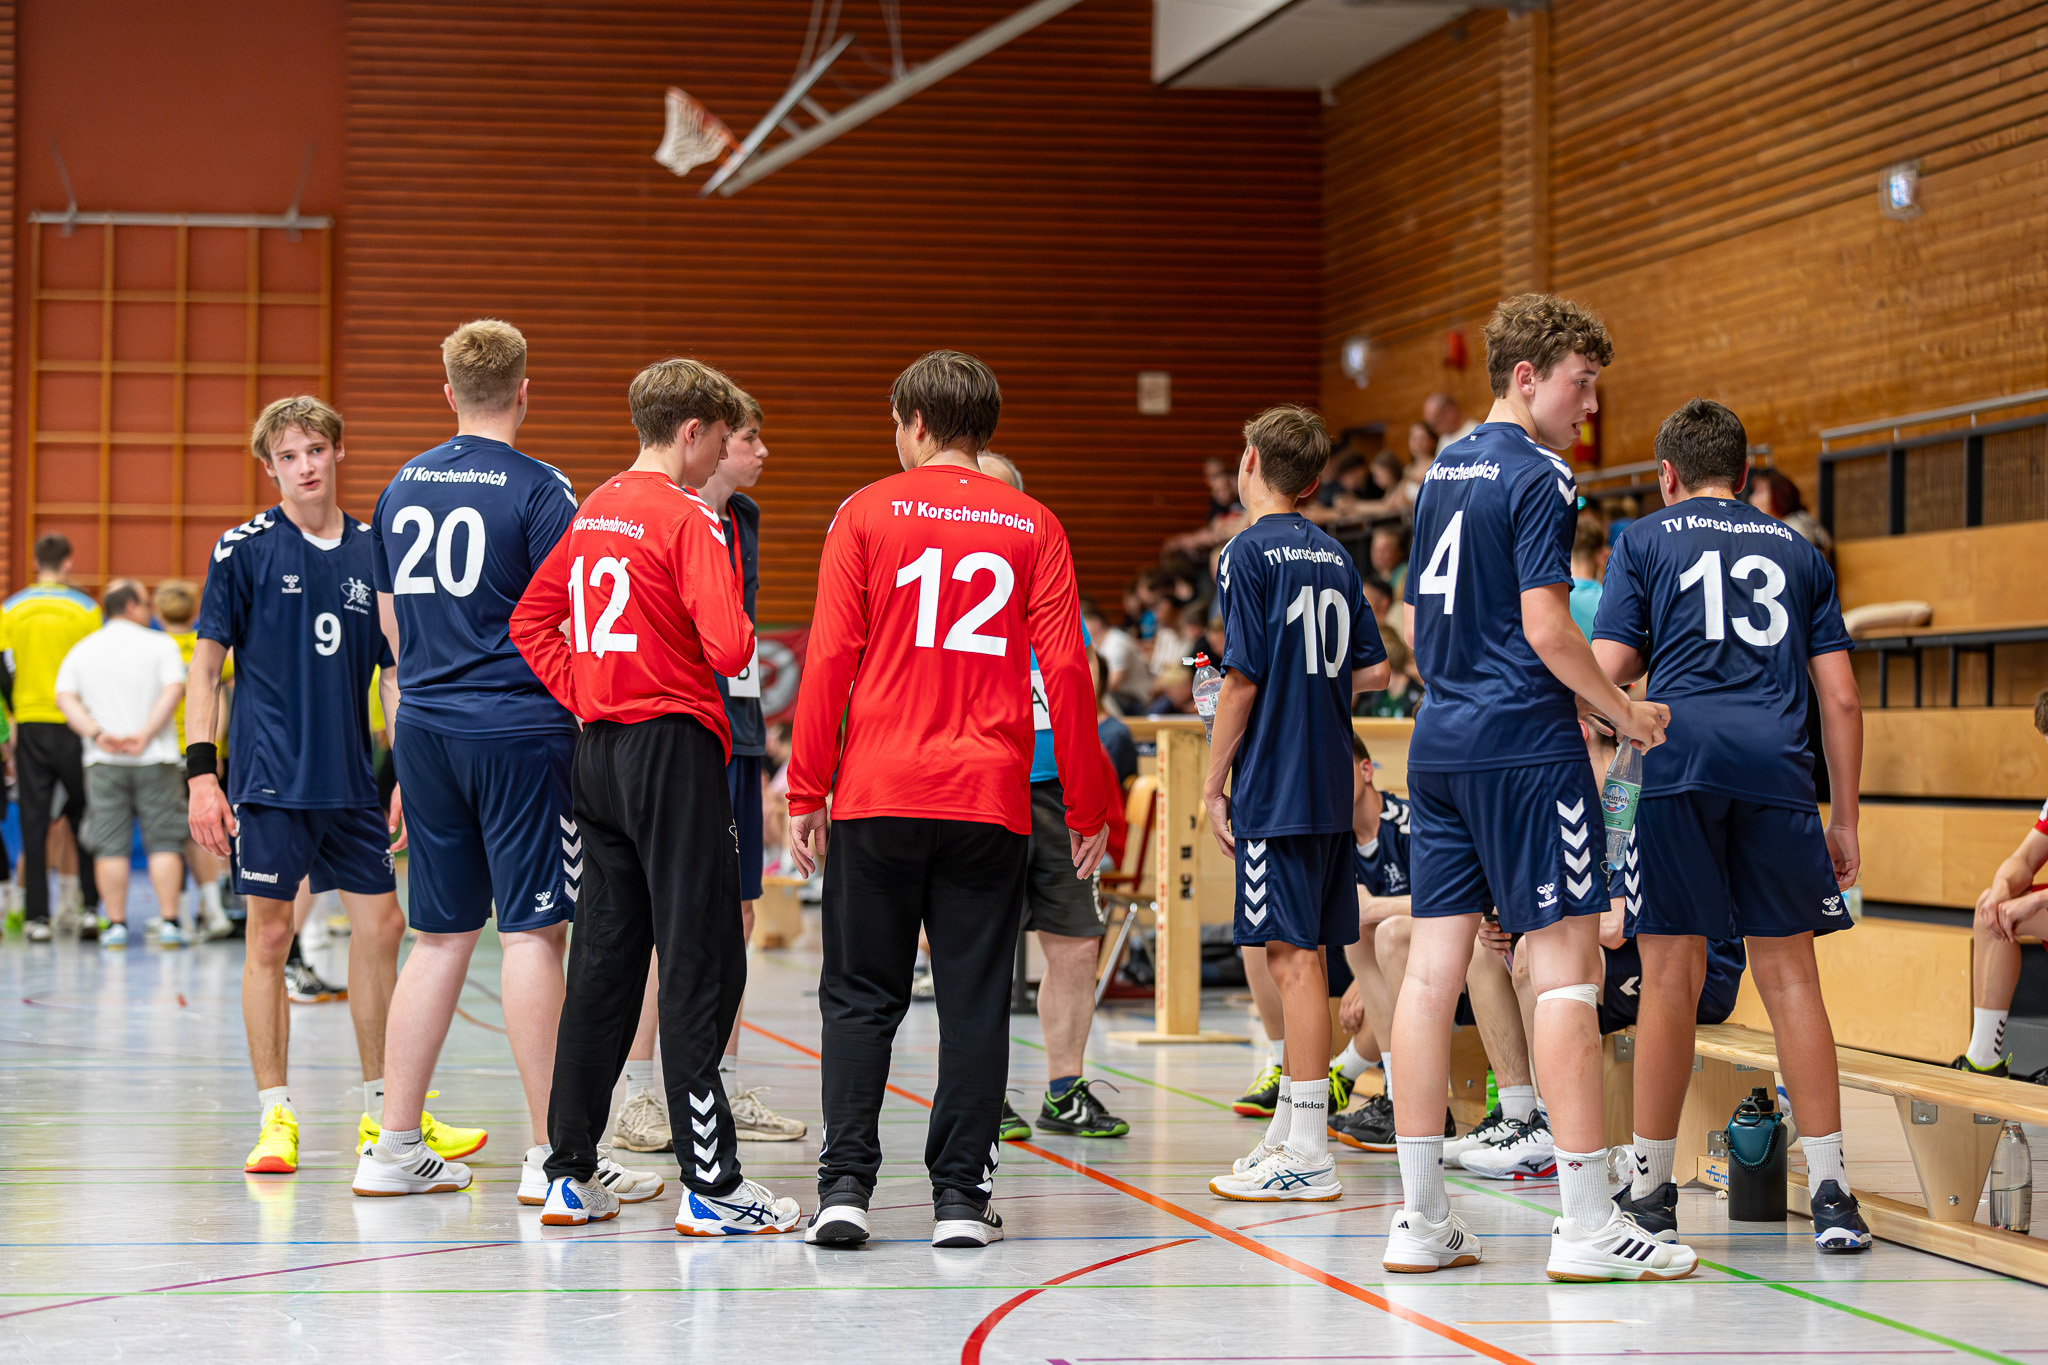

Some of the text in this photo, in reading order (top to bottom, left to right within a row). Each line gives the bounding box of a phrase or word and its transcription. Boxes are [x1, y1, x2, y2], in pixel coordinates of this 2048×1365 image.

[400, 467, 507, 487] TV Korschenbroich
[891, 501, 1035, 534] TV Korschenbroich
[1661, 515, 1793, 541] TV Korschenbroich
[391, 505, 486, 597] 20
[1263, 548, 1281, 566] TV
[1418, 510, 1464, 615] 4
[567, 555, 638, 659] 12
[895, 547, 1015, 657] 12
[1678, 550, 1790, 647] 13
[314, 612, 342, 656] 9
[1286, 585, 1351, 678] 10
[240, 867, 278, 884] hummel
[1293, 1100, 1325, 1110] adidas
